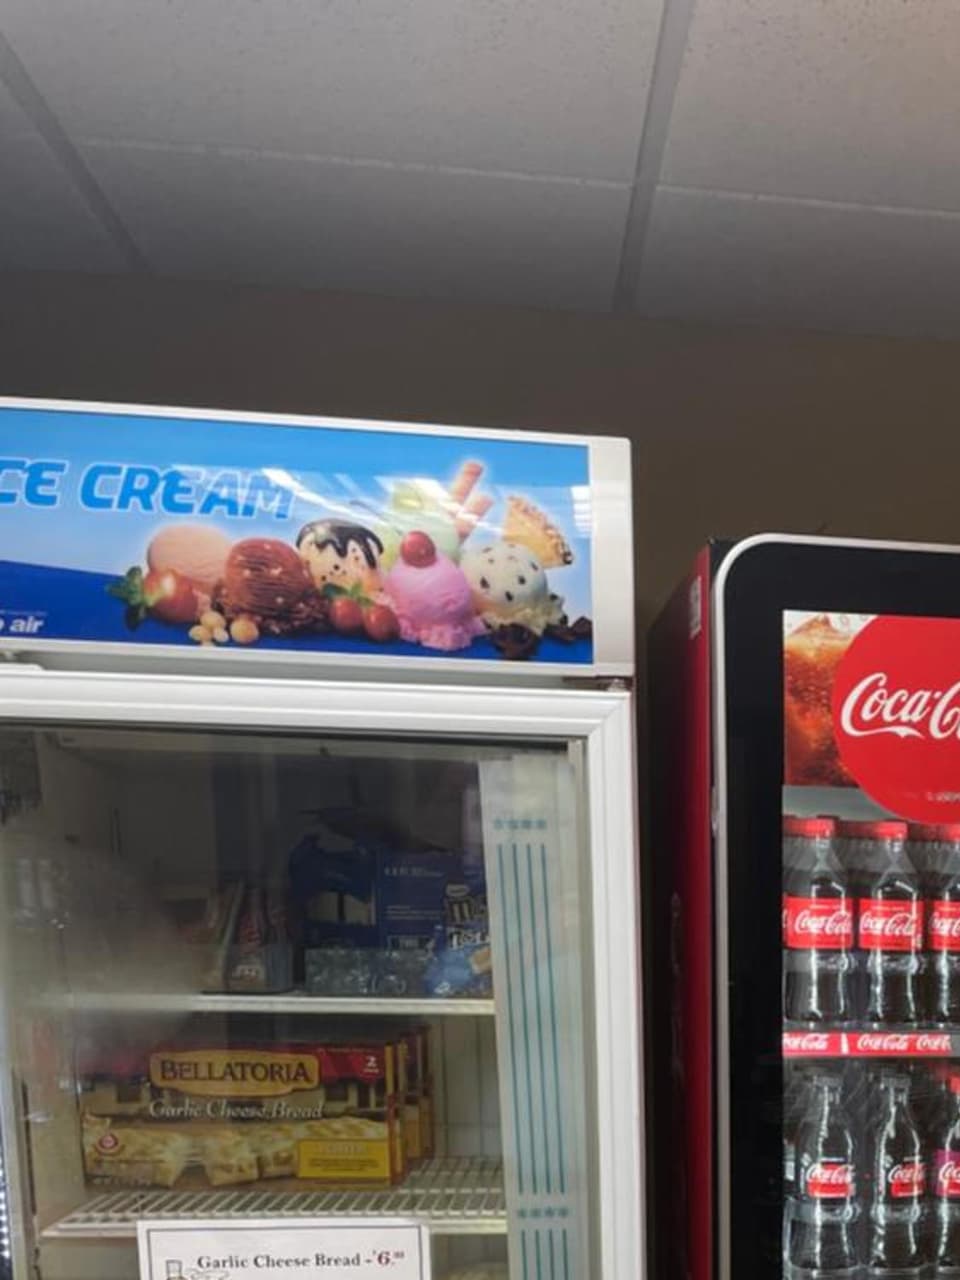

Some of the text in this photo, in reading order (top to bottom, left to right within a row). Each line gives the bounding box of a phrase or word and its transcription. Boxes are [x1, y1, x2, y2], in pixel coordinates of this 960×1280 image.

[80, 464, 294, 519] CREAM
[9, 615, 44, 633] air
[160, 1058, 315, 1083] BELLATORIA
[197, 1254, 249, 1269] Garlic
[253, 1254, 310, 1268] Cheese
[314, 1253, 361, 1267] Bread
